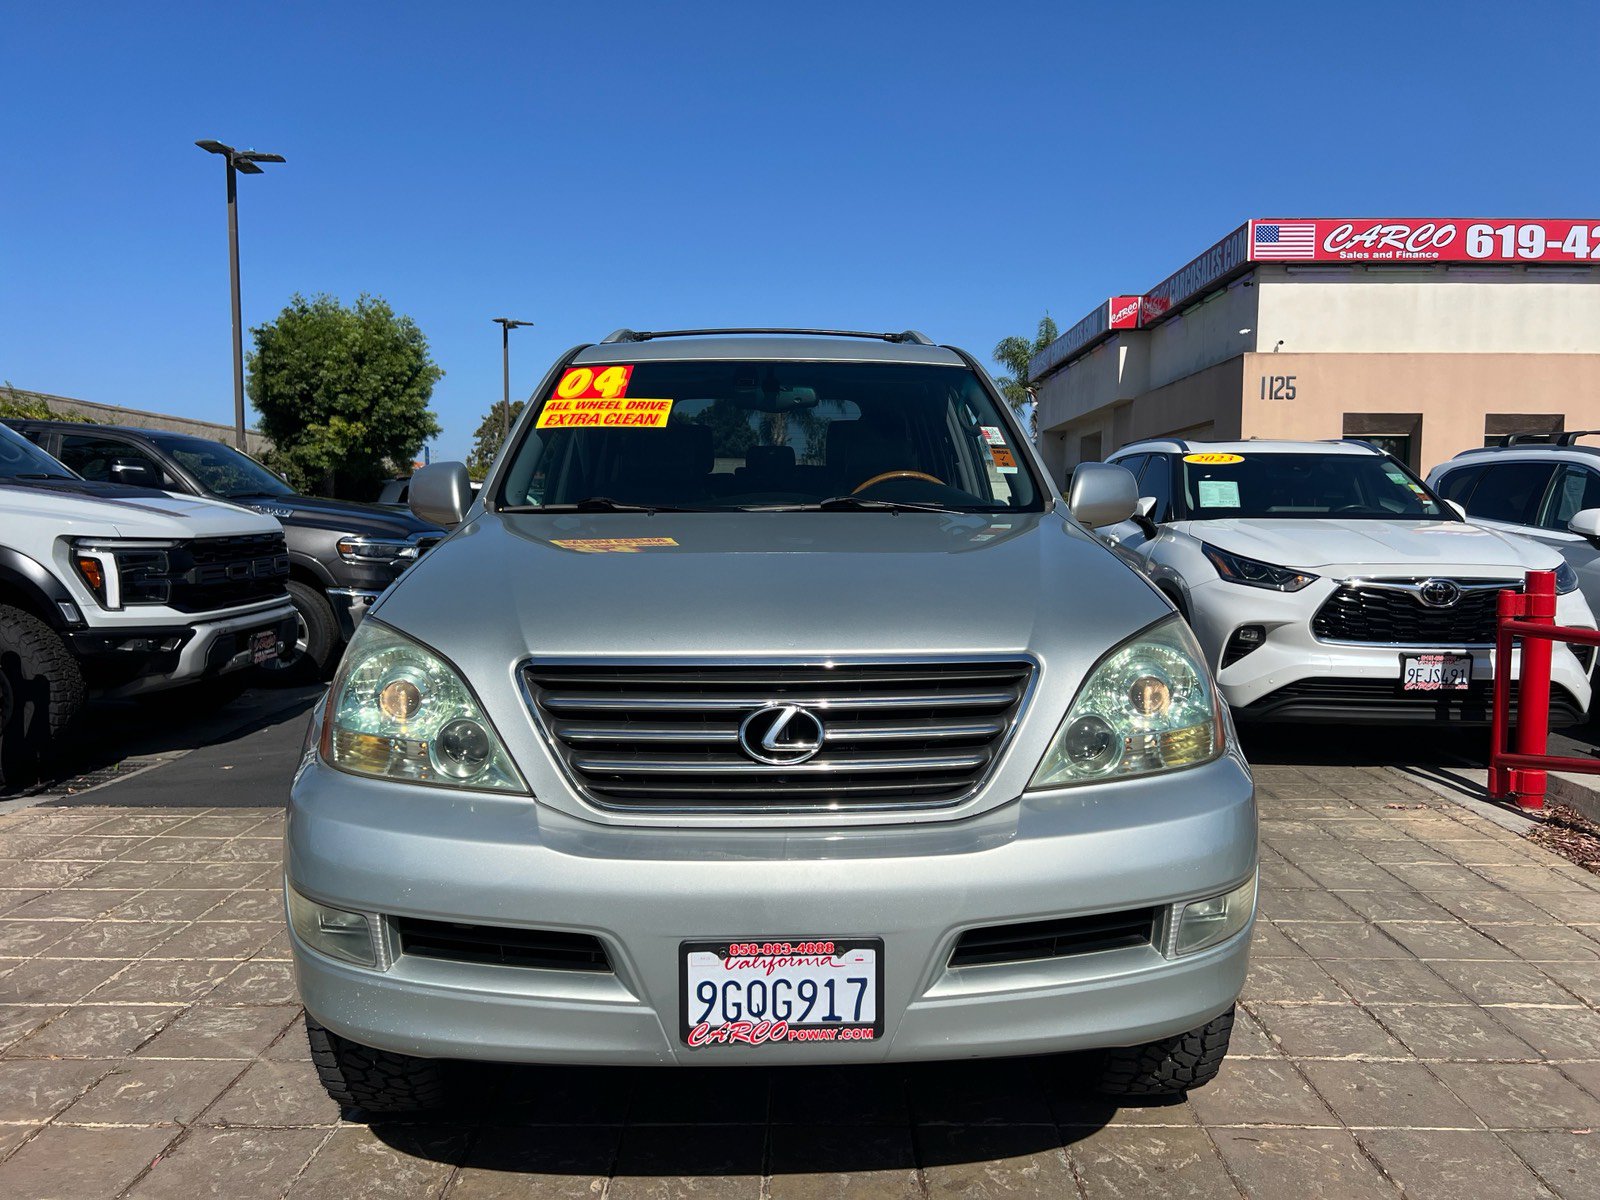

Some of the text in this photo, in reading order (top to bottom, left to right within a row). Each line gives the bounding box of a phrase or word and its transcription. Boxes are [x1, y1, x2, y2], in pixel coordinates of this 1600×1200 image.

[1324, 223, 1457, 253] CARCO
[1169, 227, 1248, 306] CARCOSALES.COM
[1339, 251, 1439, 259] Sales and Finance
[557, 366, 627, 398] 04
[1260, 375, 1297, 400] 1125
[545, 401, 668, 411] ALL WHEEL DRIVE
[544, 413, 660, 425] EXTRA CLEAN
[729, 942, 835, 956] 858-883-4888
[724, 955, 846, 976] California
[696, 977, 868, 1024] 9GQG917
[687, 1020, 789, 1047] CARCO
